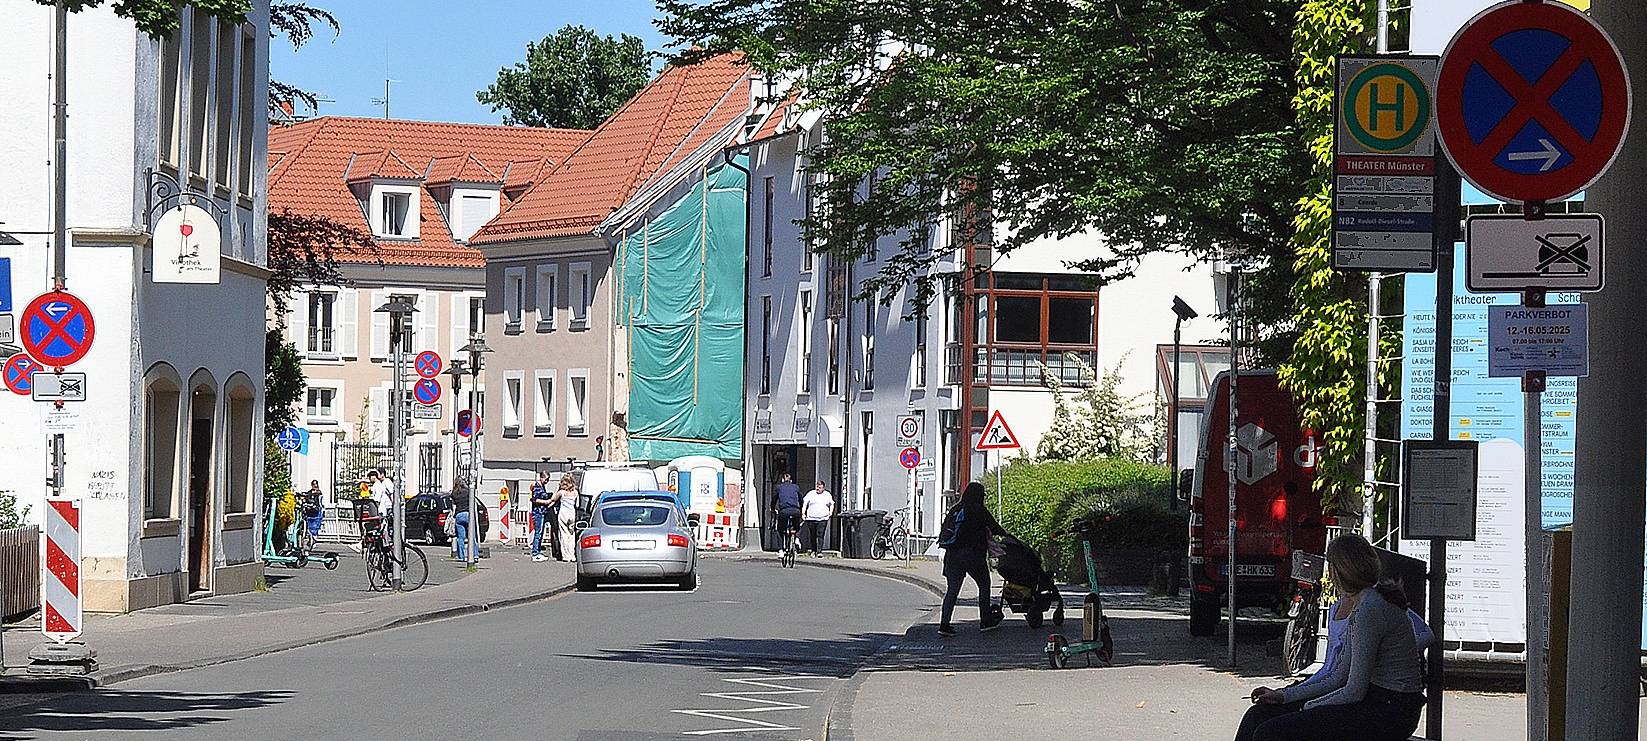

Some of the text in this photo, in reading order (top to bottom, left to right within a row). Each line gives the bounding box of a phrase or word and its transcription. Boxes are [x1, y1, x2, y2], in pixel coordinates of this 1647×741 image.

[1369, 83, 1404, 131] H
[1346, 160, 1425, 171] THEATER Münster
[1339, 217, 1355, 225] N82
[1453, 294, 1497, 305] iktheater
[1505, 310, 1572, 320] PARKVERBOT
[1507, 325, 1571, 336] 12.-16.05.2025
[1415, 405, 1432, 413] GIASO
[904, 423, 915, 433] 30
